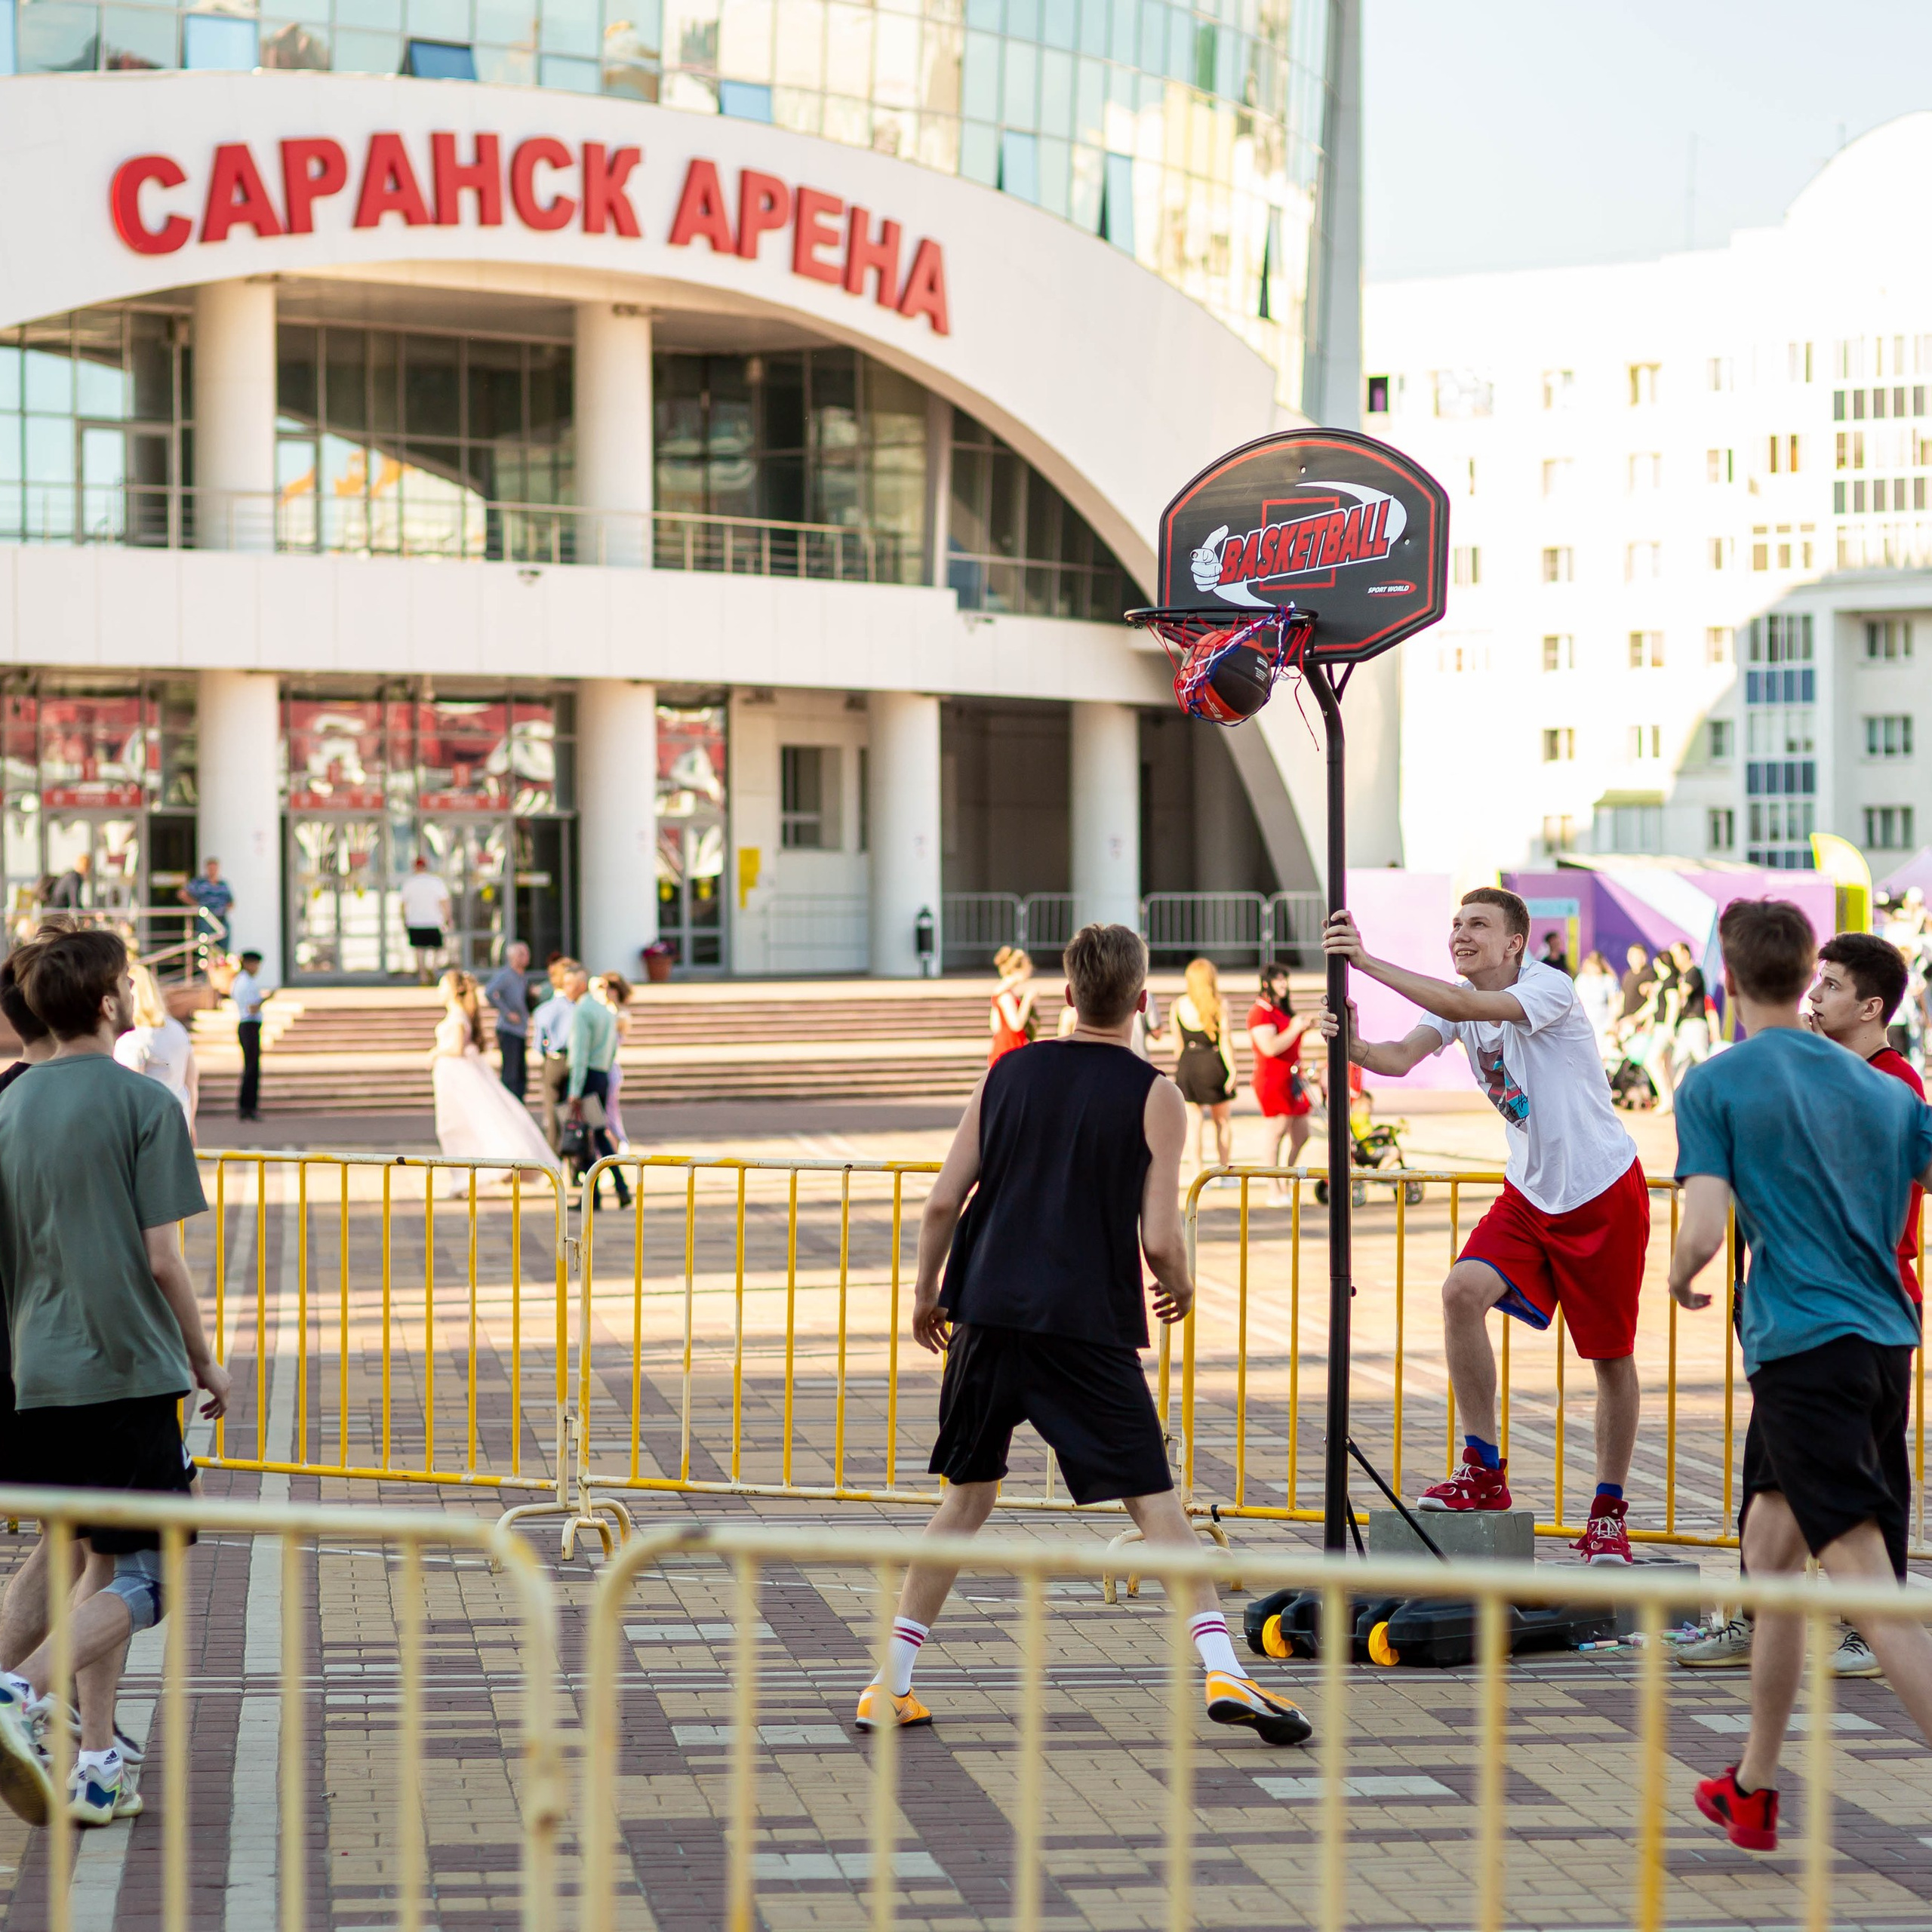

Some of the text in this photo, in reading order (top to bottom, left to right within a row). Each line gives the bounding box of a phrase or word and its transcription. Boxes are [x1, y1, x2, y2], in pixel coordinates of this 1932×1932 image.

[110, 132, 949, 335] САРАНСК АРЕНА
[1218, 497, 1391, 584] BASKETBALL
